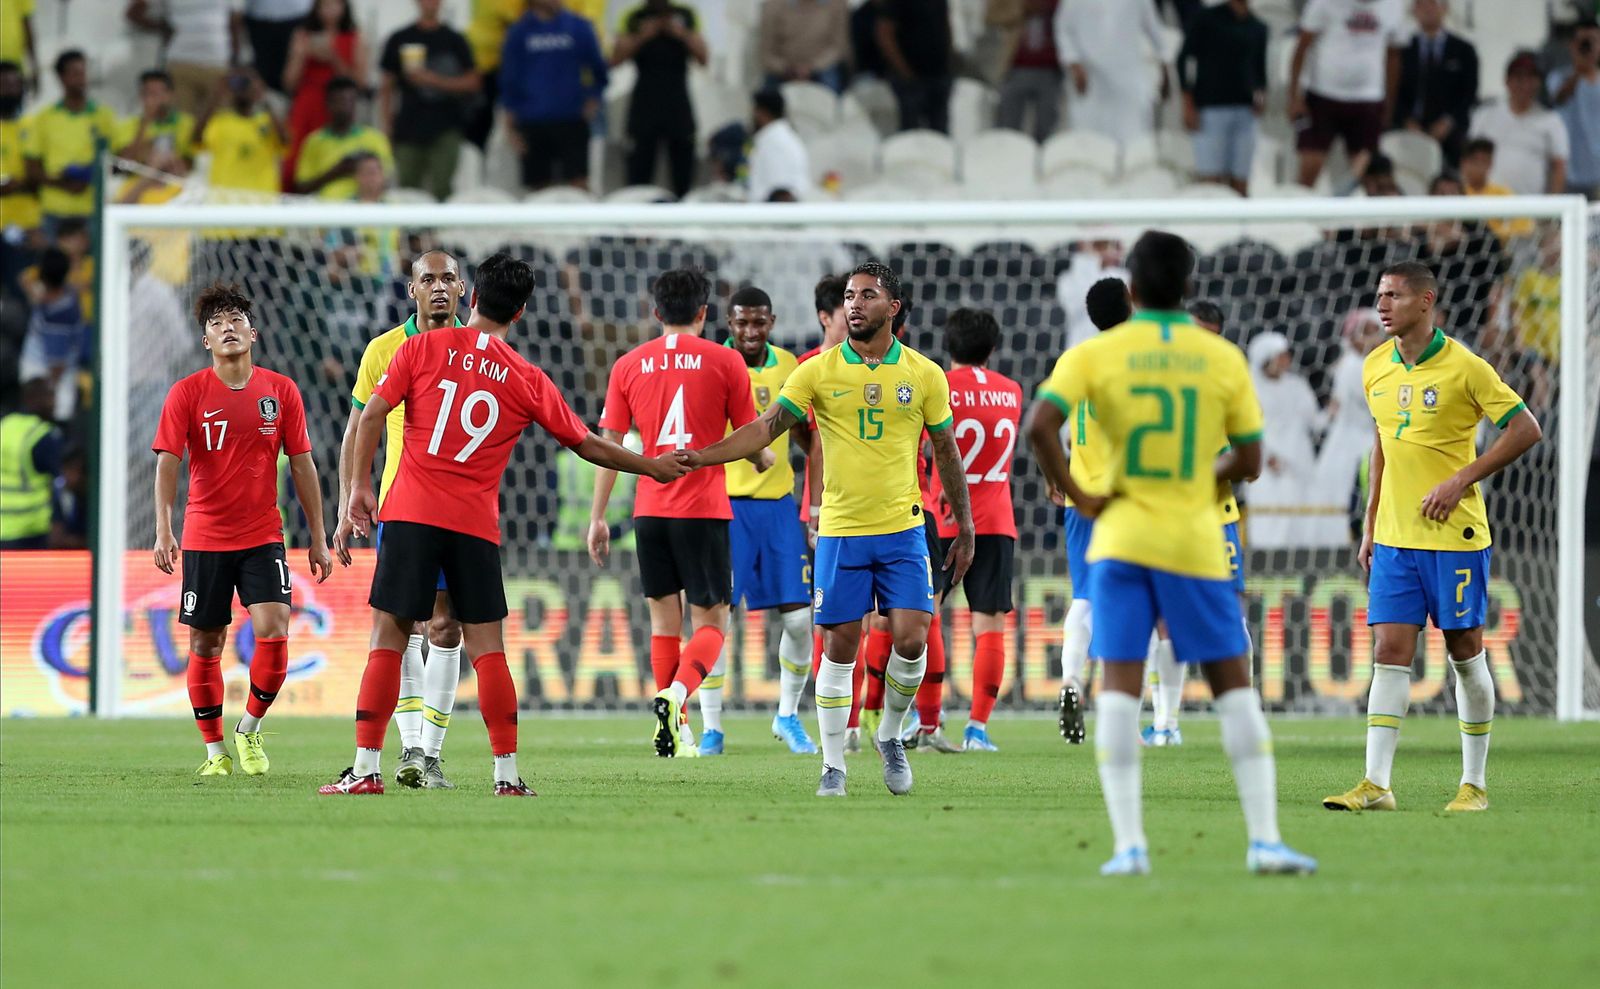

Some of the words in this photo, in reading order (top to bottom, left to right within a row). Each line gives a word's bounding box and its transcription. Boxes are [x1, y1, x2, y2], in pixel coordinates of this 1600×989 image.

[448, 348, 457, 366] Y
[462, 353, 474, 371] G
[478, 357, 509, 384] KIM
[641, 356, 654, 374] M
[660, 353, 669, 370] J
[674, 353, 702, 370] KIM
[655, 383, 693, 450] 4
[950, 390, 961, 407] C
[964, 390, 976, 407] H
[979, 390, 1017, 409] KWON
[201, 420, 228, 451] 17
[427, 378, 499, 463] 19
[856, 408, 884, 441] 15
[1125, 384, 1198, 480] 21
[1396, 410, 1411, 440] 7
[955, 417, 1016, 485] 22
[1455, 568, 1472, 603] 7
